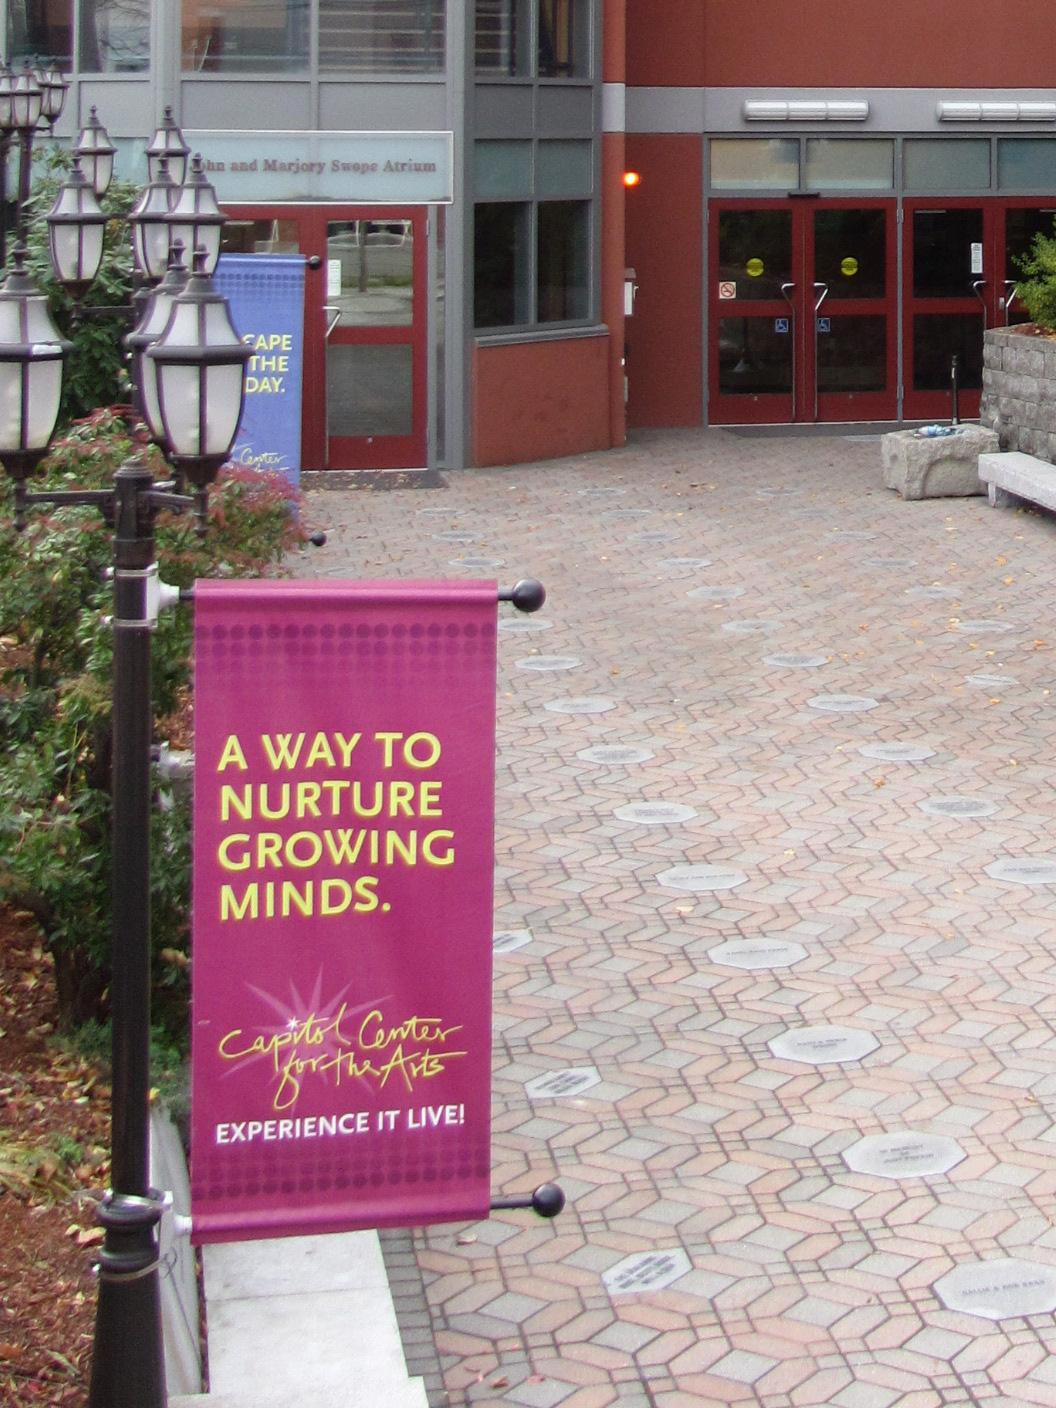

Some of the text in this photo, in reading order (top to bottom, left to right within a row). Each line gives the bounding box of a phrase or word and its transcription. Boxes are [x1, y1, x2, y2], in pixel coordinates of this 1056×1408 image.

[231, 159, 258, 172] and
[263, 158, 326, 175] Marjory
[331, 159, 378, 174] Swope
[384, 158, 436, 172] Atrium
[245, 376, 285, 393] DAY.
[249, 355, 289, 372] THE
[217, 731, 442, 772] A WAY TO
[220, 779, 444, 822] NURTURE
[217, 828, 456, 871] GROWING
[220, 875, 392, 922] MINDS.
[218, 1002, 464, 1073] Capitol Center
[272, 1043, 469, 1111] for the Arts
[215, 1102, 466, 1145] EXPERIENCE IT LIVE!
